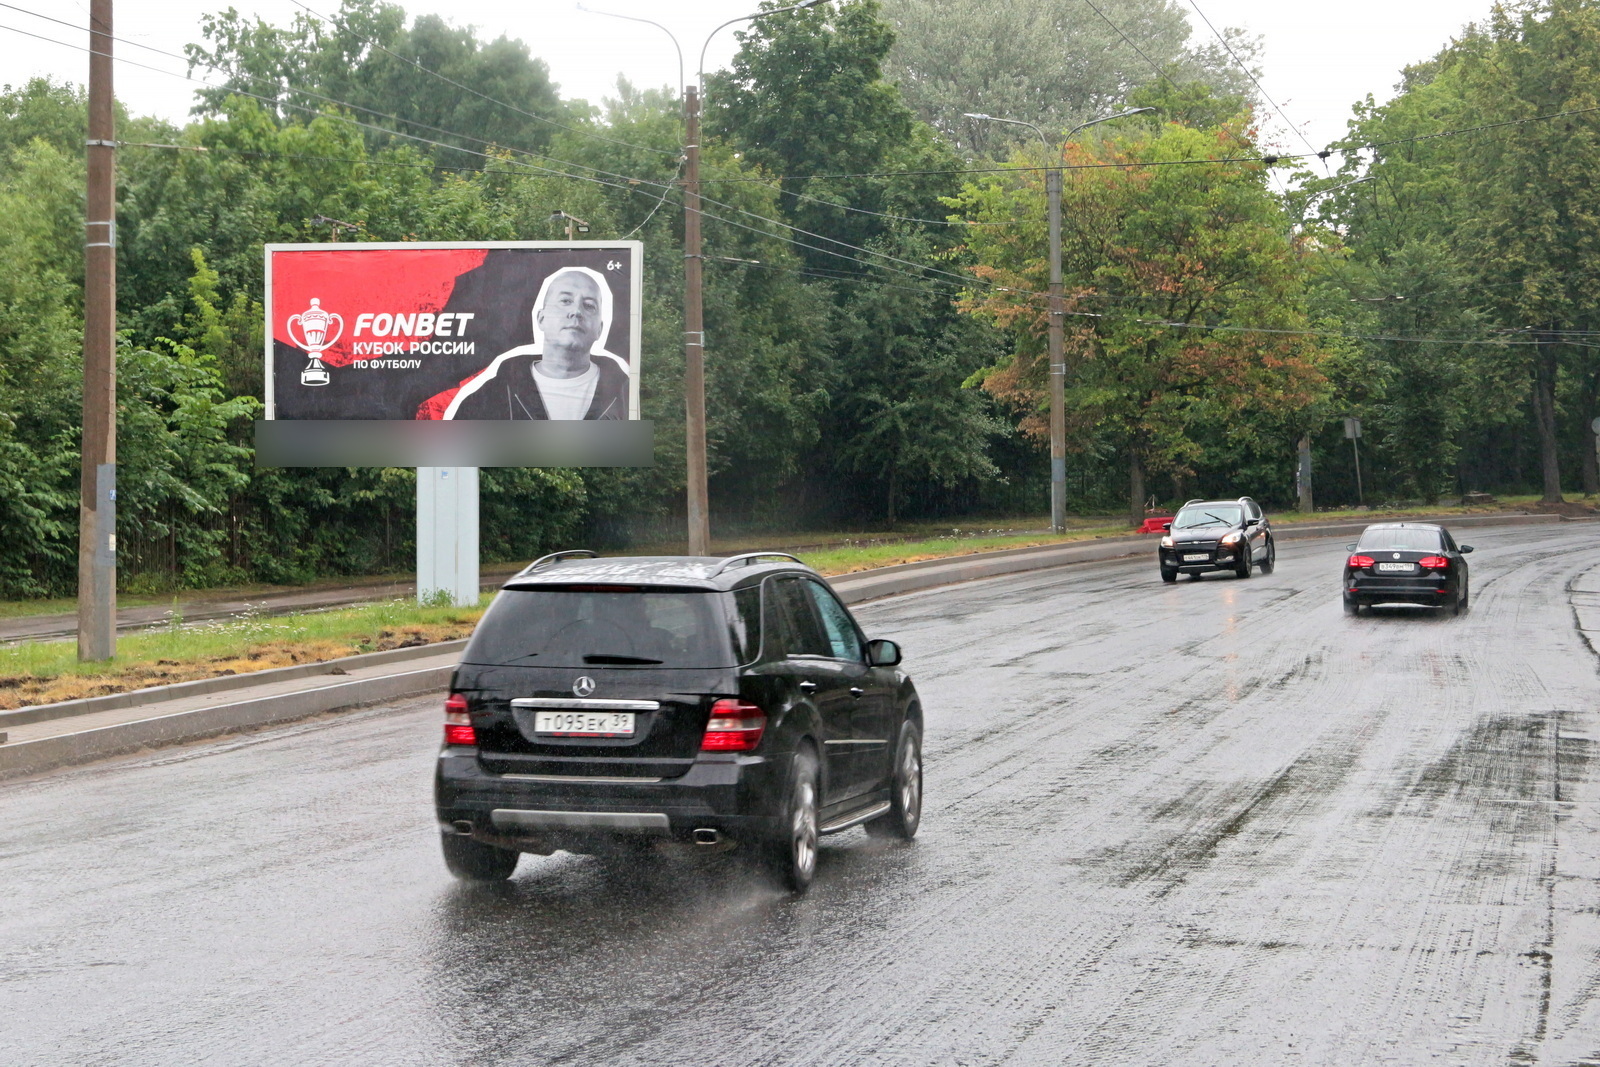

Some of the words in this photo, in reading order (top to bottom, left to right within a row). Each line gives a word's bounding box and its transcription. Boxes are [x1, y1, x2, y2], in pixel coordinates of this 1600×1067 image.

[607, 260, 622, 271] 6+
[353, 313, 475, 337] FONBET
[353, 341, 404, 355] КУБОК
[410, 341, 475, 355] РОССИИ
[353, 360, 368, 369] ПО
[370, 359, 421, 369] ФУТБОЛУ
[612, 714, 629, 727] 39
